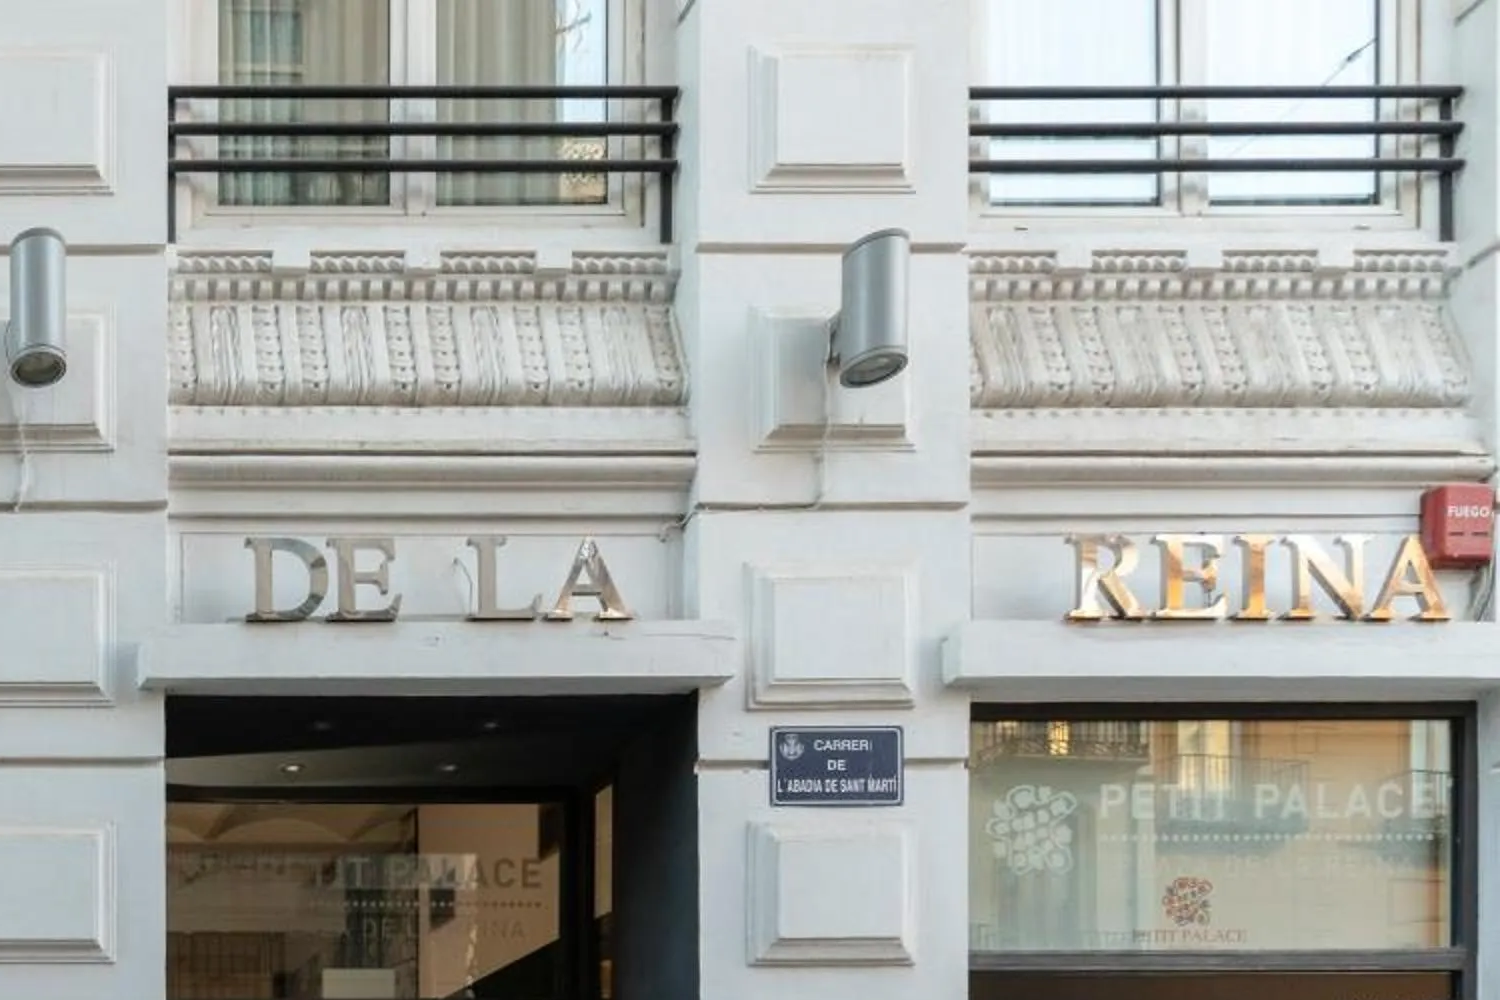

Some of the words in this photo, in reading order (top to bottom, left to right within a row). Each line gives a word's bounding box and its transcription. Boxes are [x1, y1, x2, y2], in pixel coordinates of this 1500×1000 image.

[1447, 505, 1490, 518] FUEGO
[244, 536, 403, 623] DE
[467, 535, 634, 623] LA
[1064, 533, 1451, 623] REINA
[813, 739, 870, 751] CARRER
[827, 759, 847, 771] DE
[825, 779, 839, 793] DE
[841, 779, 866, 793] SANT
[1100, 783, 1231, 820] PETIT
[1253, 783, 1435, 820] PALACE
